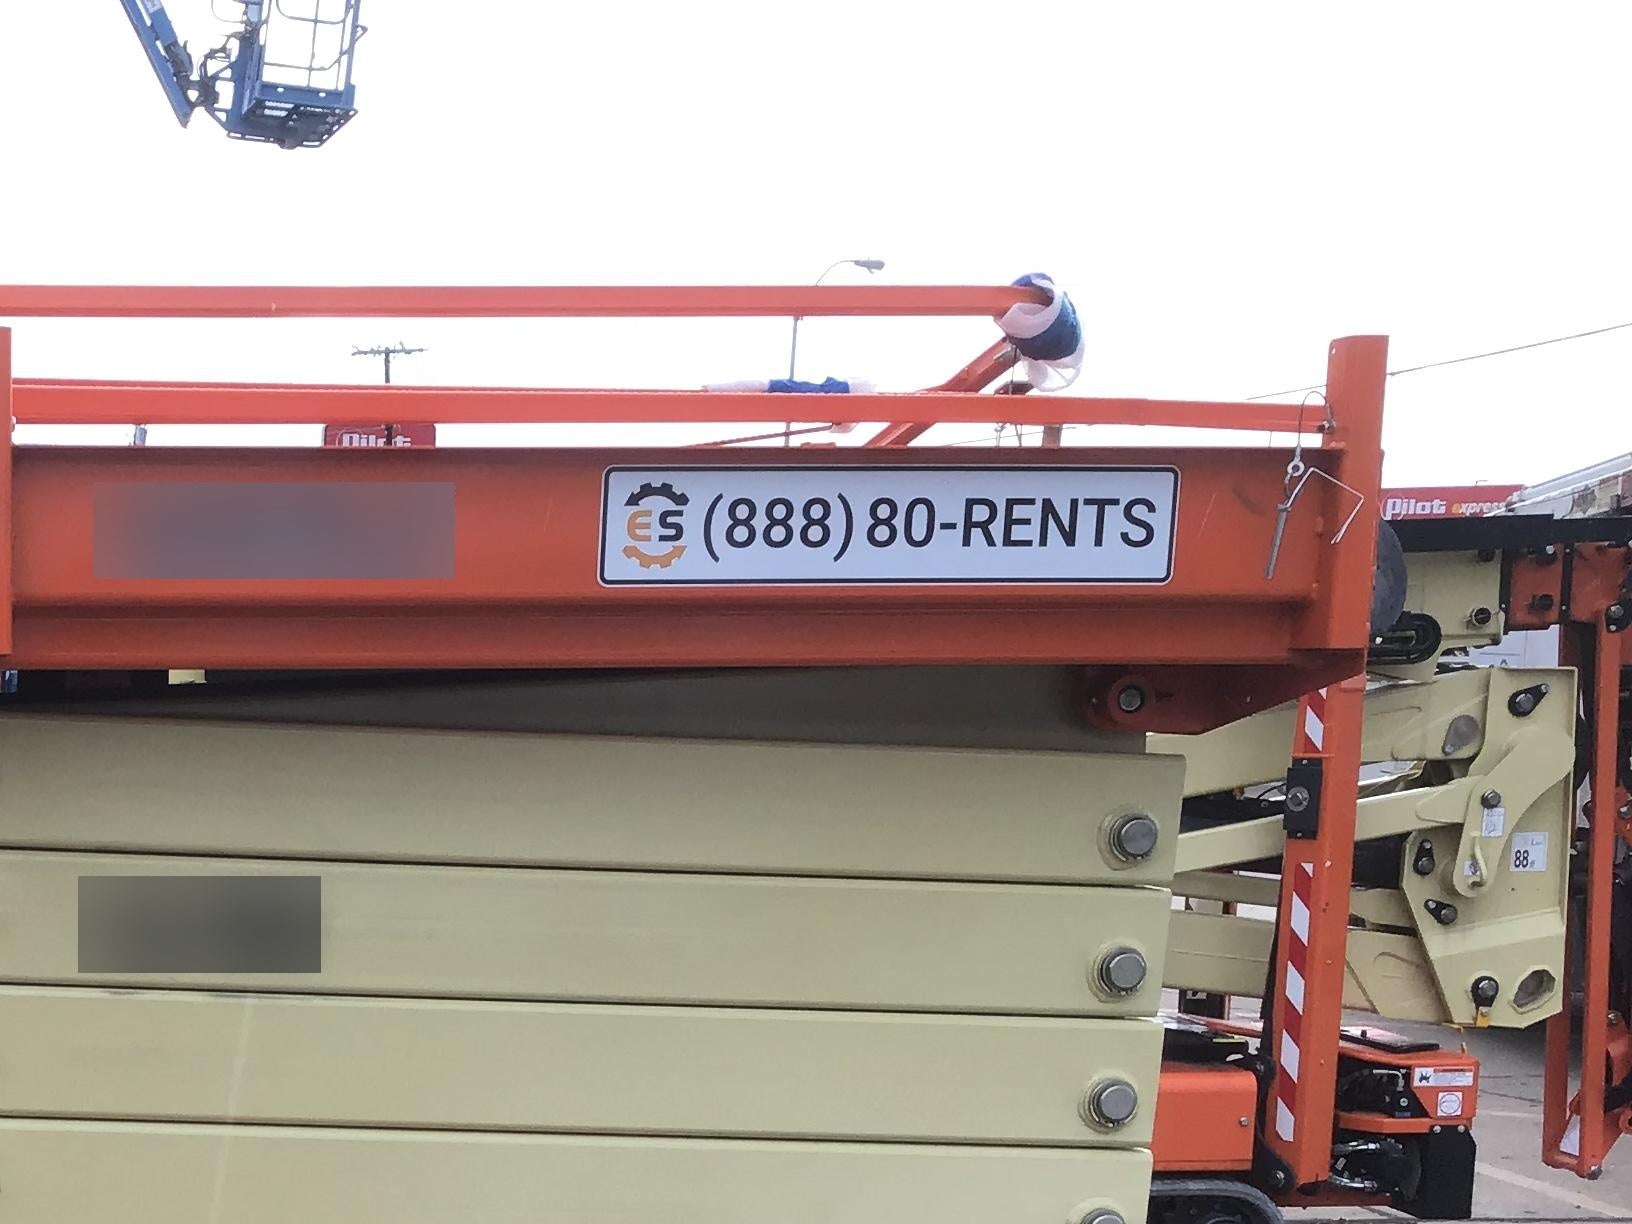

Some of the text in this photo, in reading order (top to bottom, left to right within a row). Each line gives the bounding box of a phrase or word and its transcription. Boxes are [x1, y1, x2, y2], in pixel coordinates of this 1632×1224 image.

[1386, 498, 1447, 520] Pilot
[627, 510, 684, 542] ES
[1514, 849, 1529, 868] 88
